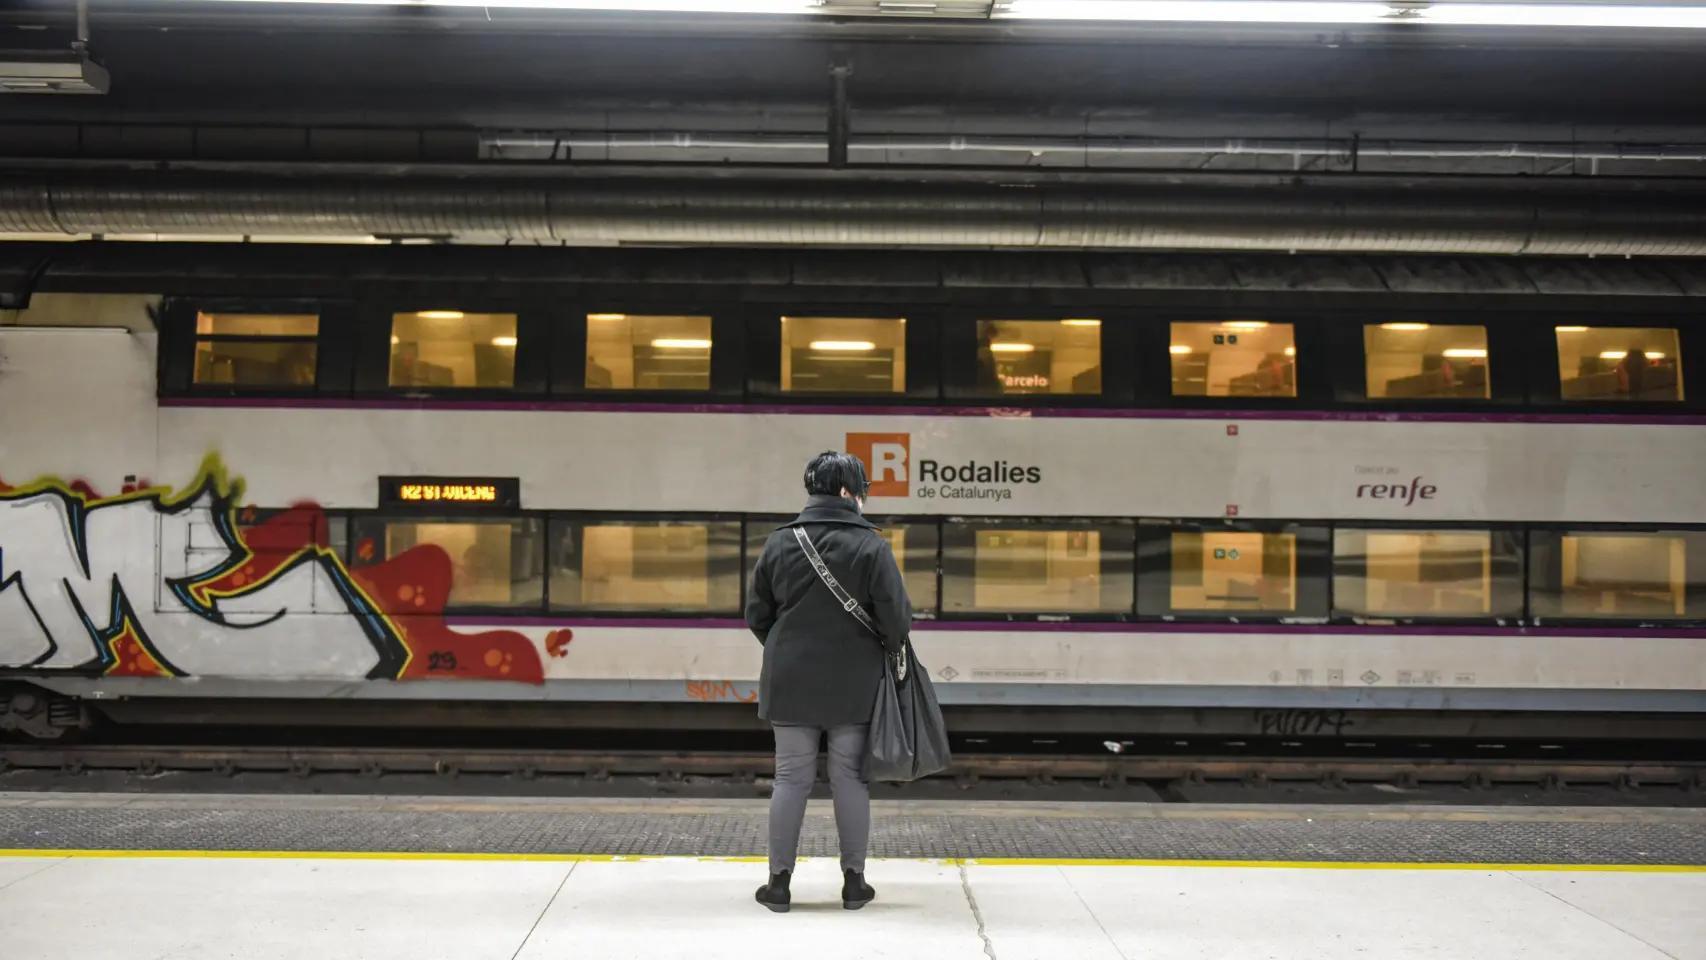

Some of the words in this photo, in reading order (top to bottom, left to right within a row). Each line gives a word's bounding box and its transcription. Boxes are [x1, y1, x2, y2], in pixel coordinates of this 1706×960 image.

[871, 443, 907, 481] R
[919, 460, 1041, 484] Rodalies
[917, 485, 935, 498] de
[940, 485, 1012, 502] Catalunya
[1356, 476, 1437, 506] renfe
